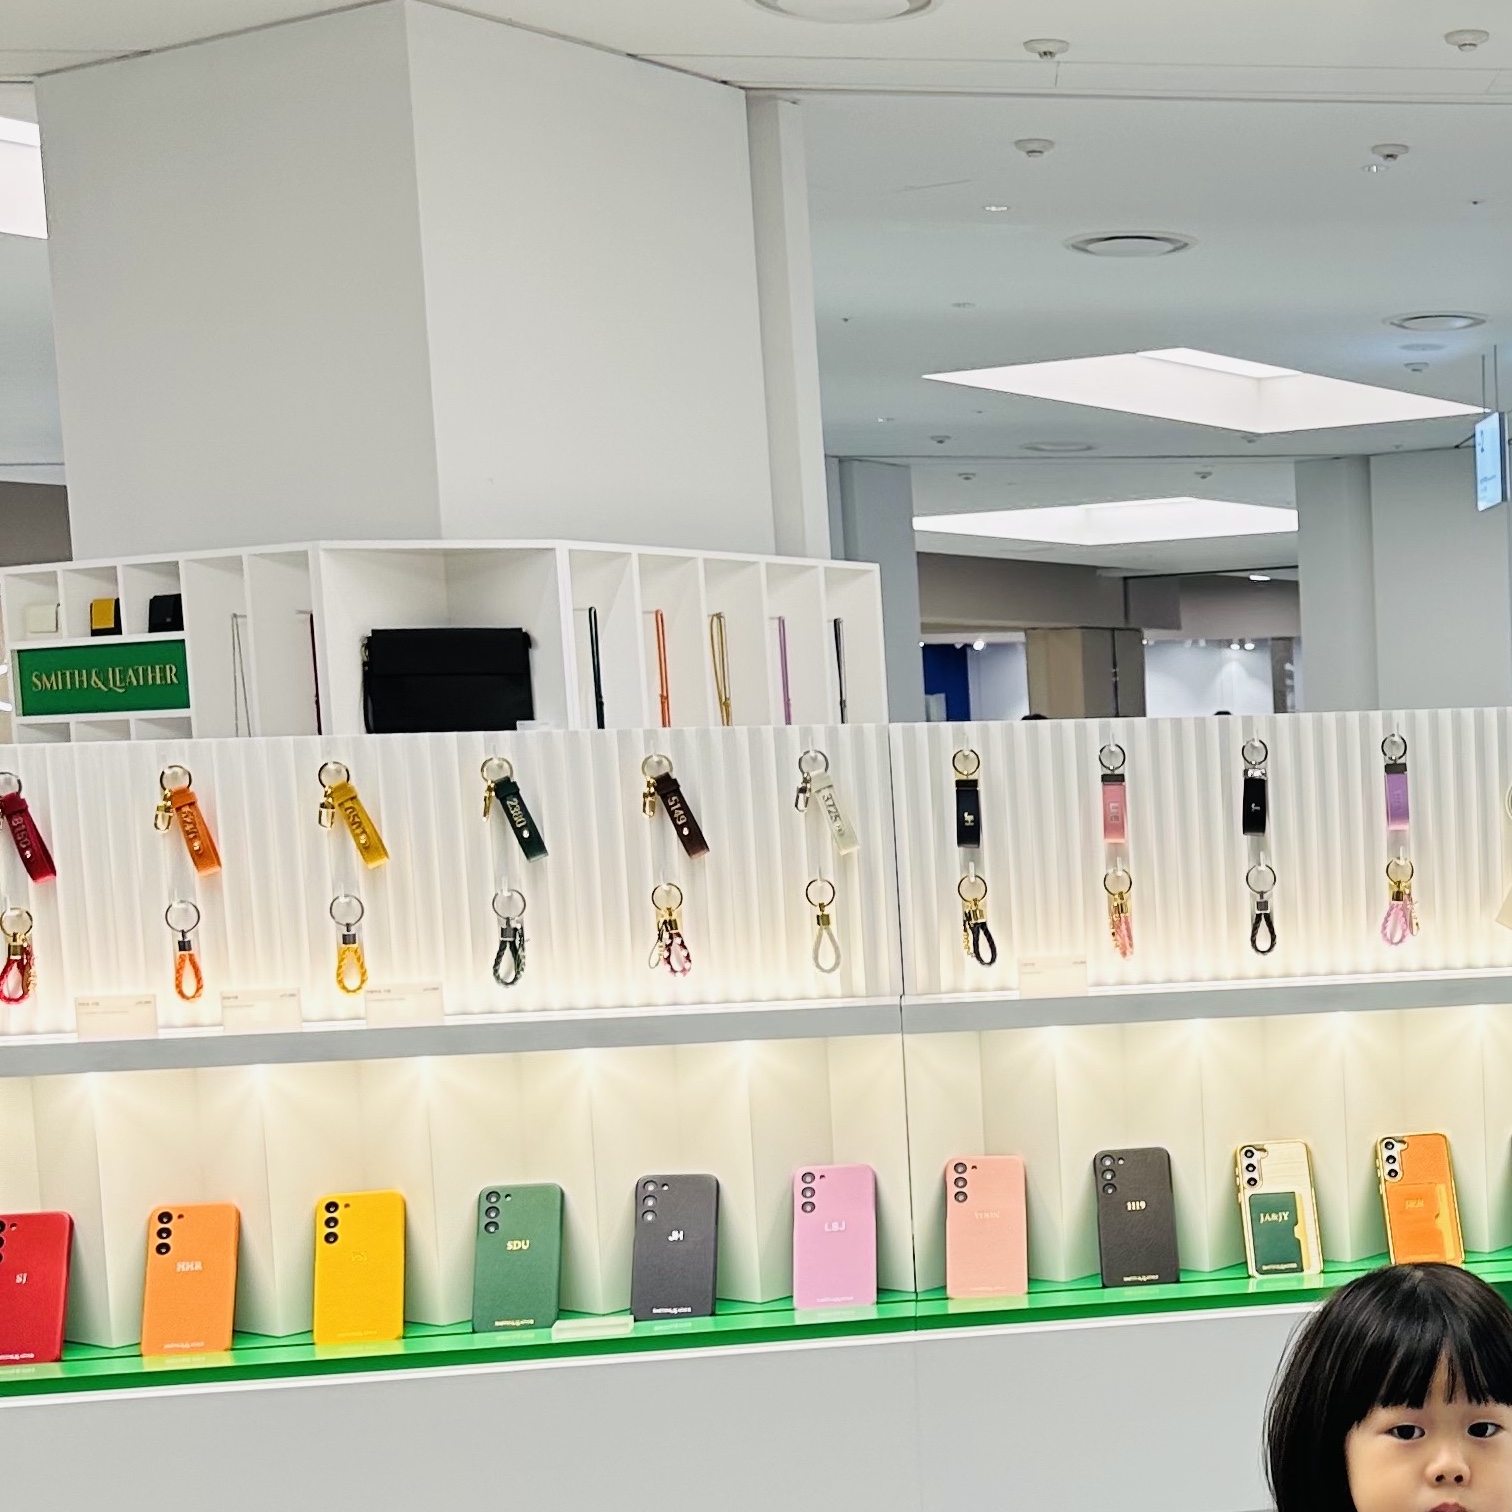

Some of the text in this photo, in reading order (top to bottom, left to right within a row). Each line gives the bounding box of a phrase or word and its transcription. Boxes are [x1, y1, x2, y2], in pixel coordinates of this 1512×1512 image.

[31, 664, 179, 693] SMITH & LEATHER
[667, 795, 687, 825] 5149
